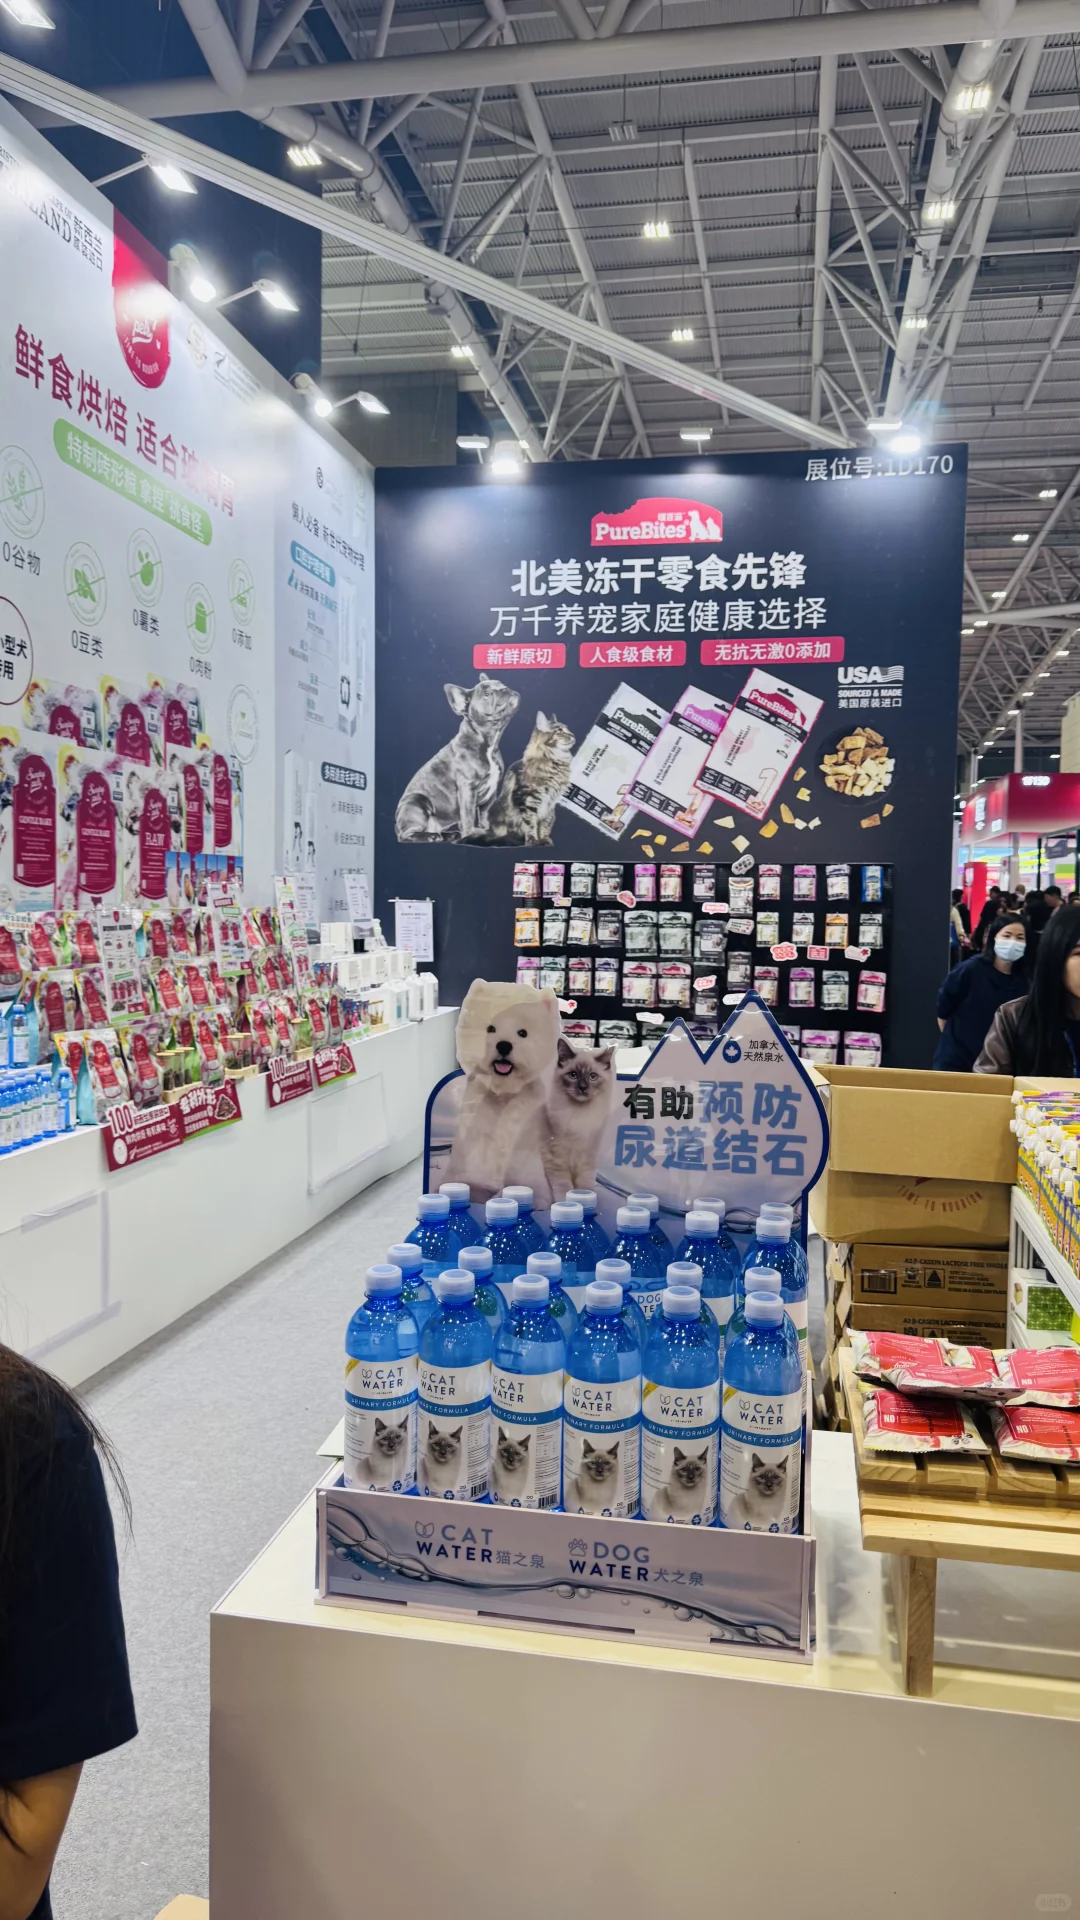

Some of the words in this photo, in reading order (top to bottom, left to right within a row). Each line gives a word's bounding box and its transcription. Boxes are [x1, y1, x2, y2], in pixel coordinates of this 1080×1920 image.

[73, 215, 103, 256] 新西兰
[15, 323, 128, 446] 鲜食烘焙
[595, 521, 687, 541] PureBites
[3, 541, 41, 576] 0谷物
[511, 551, 807, 596] 北美冻干零食先锋
[489, 596, 827, 638] 万千养宠家庭健康选择
[71, 630, 104, 659] 0豆类
[714, 641, 831, 661] 无抗无激0添加
[486, 648, 553, 664] 新鲜原切
[589, 645, 674, 663] 人食级食材
[838, 666, 883, 684] USA
[838, 689, 872, 698] SOURCED
[873, 689, 879, 697] &
[880, 689, 903, 697] MADE
[750, 691, 795, 720] PureBites
[838, 698, 902, 708] 美国原装进口
[145, 832, 165, 846] RAW
[748, 1039, 779, 1051] 加拿大
[743, 1051, 784, 1063] 天然泉水
[614, 1125, 807, 1177] 尿道结石
[897, 1184, 920, 1205] TIME
[925, 1199, 935, 1211] TO
[942, 1190, 983, 1212] NOURISH
[637, 1293, 661, 1304] DOG
[375, 1367, 403, 1379] CAT
[429, 1373, 455, 1385] CAT
[362, 1379, 403, 1389] WATER
[499, 1378, 524, 1392] CAT
[583, 1390, 612, 1401] CAT
[674, 1396, 703, 1407] CAT
[572, 1397, 612, 1412] WATER
[753, 1403, 783, 1414] CAT
[503, 1412, 537, 1422] FORMULA
[660, 1406, 703, 1418] WATER
[740, 1411, 783, 1425] WATER
[884, 1414, 895, 1423] NO
[590, 1422, 624, 1430] FORMULA
[648, 1423, 678, 1436] URINARY
[681, 1427, 713, 1437] FORMULA
[1016, 1424, 1029, 1433] NO
[728, 1428, 757, 1442] URINARY
[760, 1435, 793, 1444] FORMULA
[441, 1524, 493, 1546] CAT
[416, 1541, 493, 1563] WATER
[496, 1550, 545, 1569] 猫之泉
[594, 1541, 650, 1564] DOG
[570, 1559, 649, 1582] WATER
[653, 1567, 704, 1587] 犬之泉
